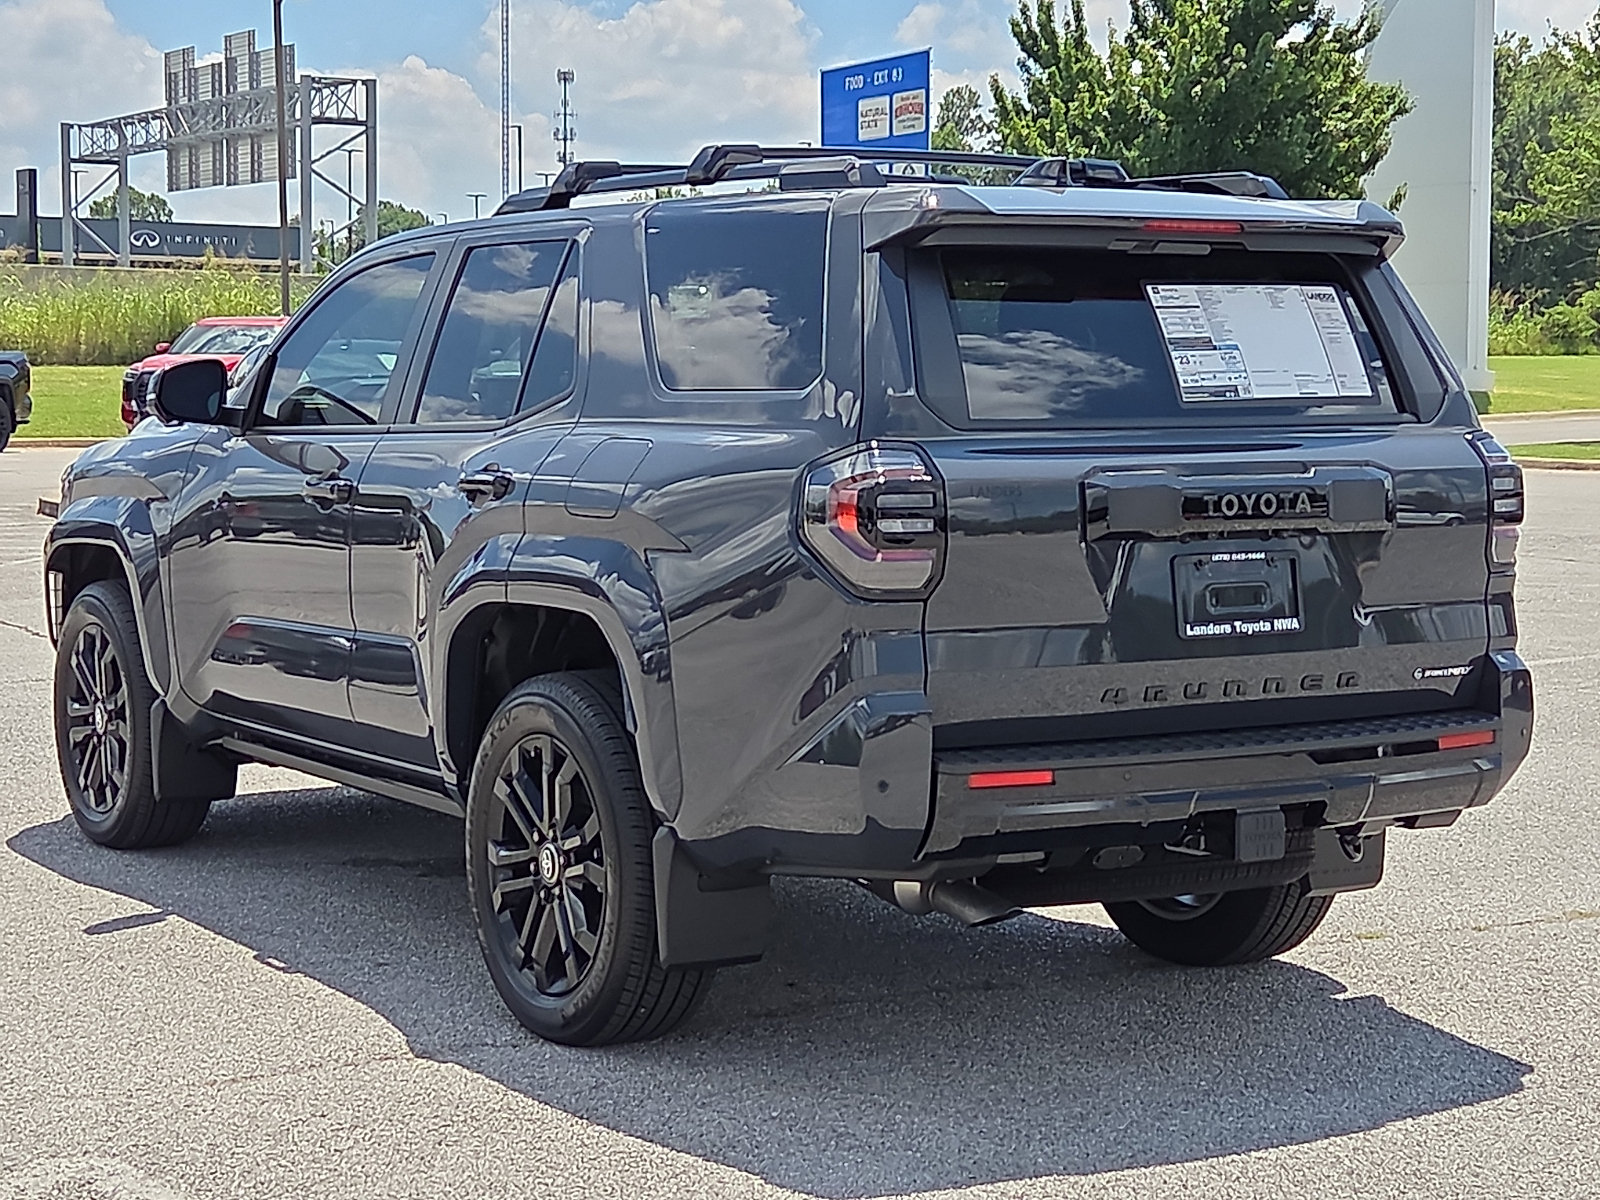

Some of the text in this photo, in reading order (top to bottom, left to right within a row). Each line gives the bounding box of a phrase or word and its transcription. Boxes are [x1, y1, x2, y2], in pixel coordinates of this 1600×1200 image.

[845, 75, 863, 91] FOOD
[874, 69, 888, 86] EXIT
[166, 235, 237, 247] INFINITI
[1179, 355, 1191, 365] 23
[1203, 492, 1312, 516] TOYOTA
[1186, 617, 1300, 636] Landers Toyota NWA
[1100, 671, 1360, 705] 4RUNNER
